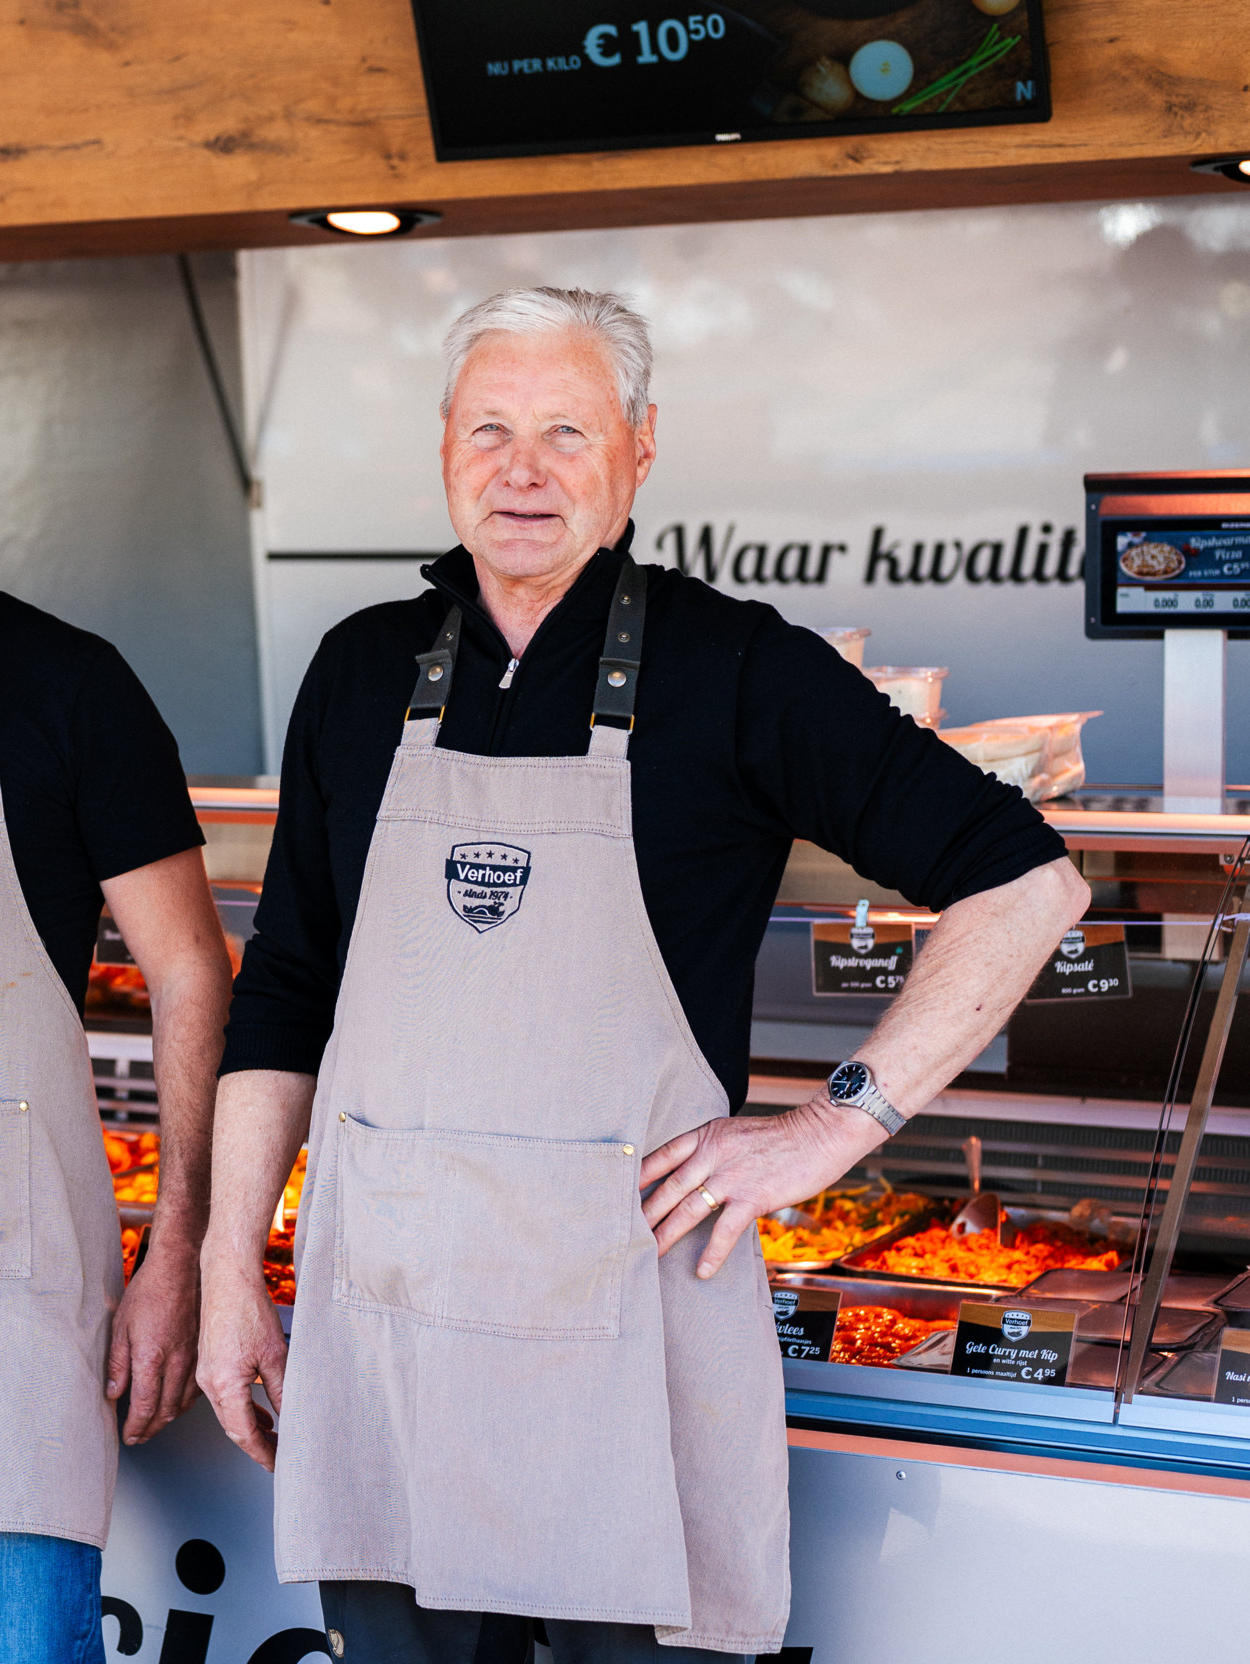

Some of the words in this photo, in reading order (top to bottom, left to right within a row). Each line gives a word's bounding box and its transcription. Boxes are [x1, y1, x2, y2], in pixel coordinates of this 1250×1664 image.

[487, 61, 509, 76] NU
[513, 58, 543, 74] PER
[547, 55, 581, 71] KILO
[656, 521, 848, 585] Waar
[863, 522, 1086, 586] kwalit
[456, 863, 524, 884] Verhoef
[463, 889, 487, 900] sinds
[488, 890, 510, 901] 1974
[829, 954, 898, 971] Kipstroganoff
[1054, 959, 1094, 975] Kipsaté
[1005, 1318, 1028, 1326] Verhoef
[966, 1341, 987, 1354] Gele
[989, 1344, 1018, 1359] Curry
[1019, 1349, 1038, 1359] met
[1040, 1349, 1058, 1363] Kip
[1016, 1359, 1027, 1367] rijst
[971, 1368, 994, 1376] persoons
[995, 1370, 1017, 1378] maaltijd
[1225, 1370, 1247, 1382] Nasi
